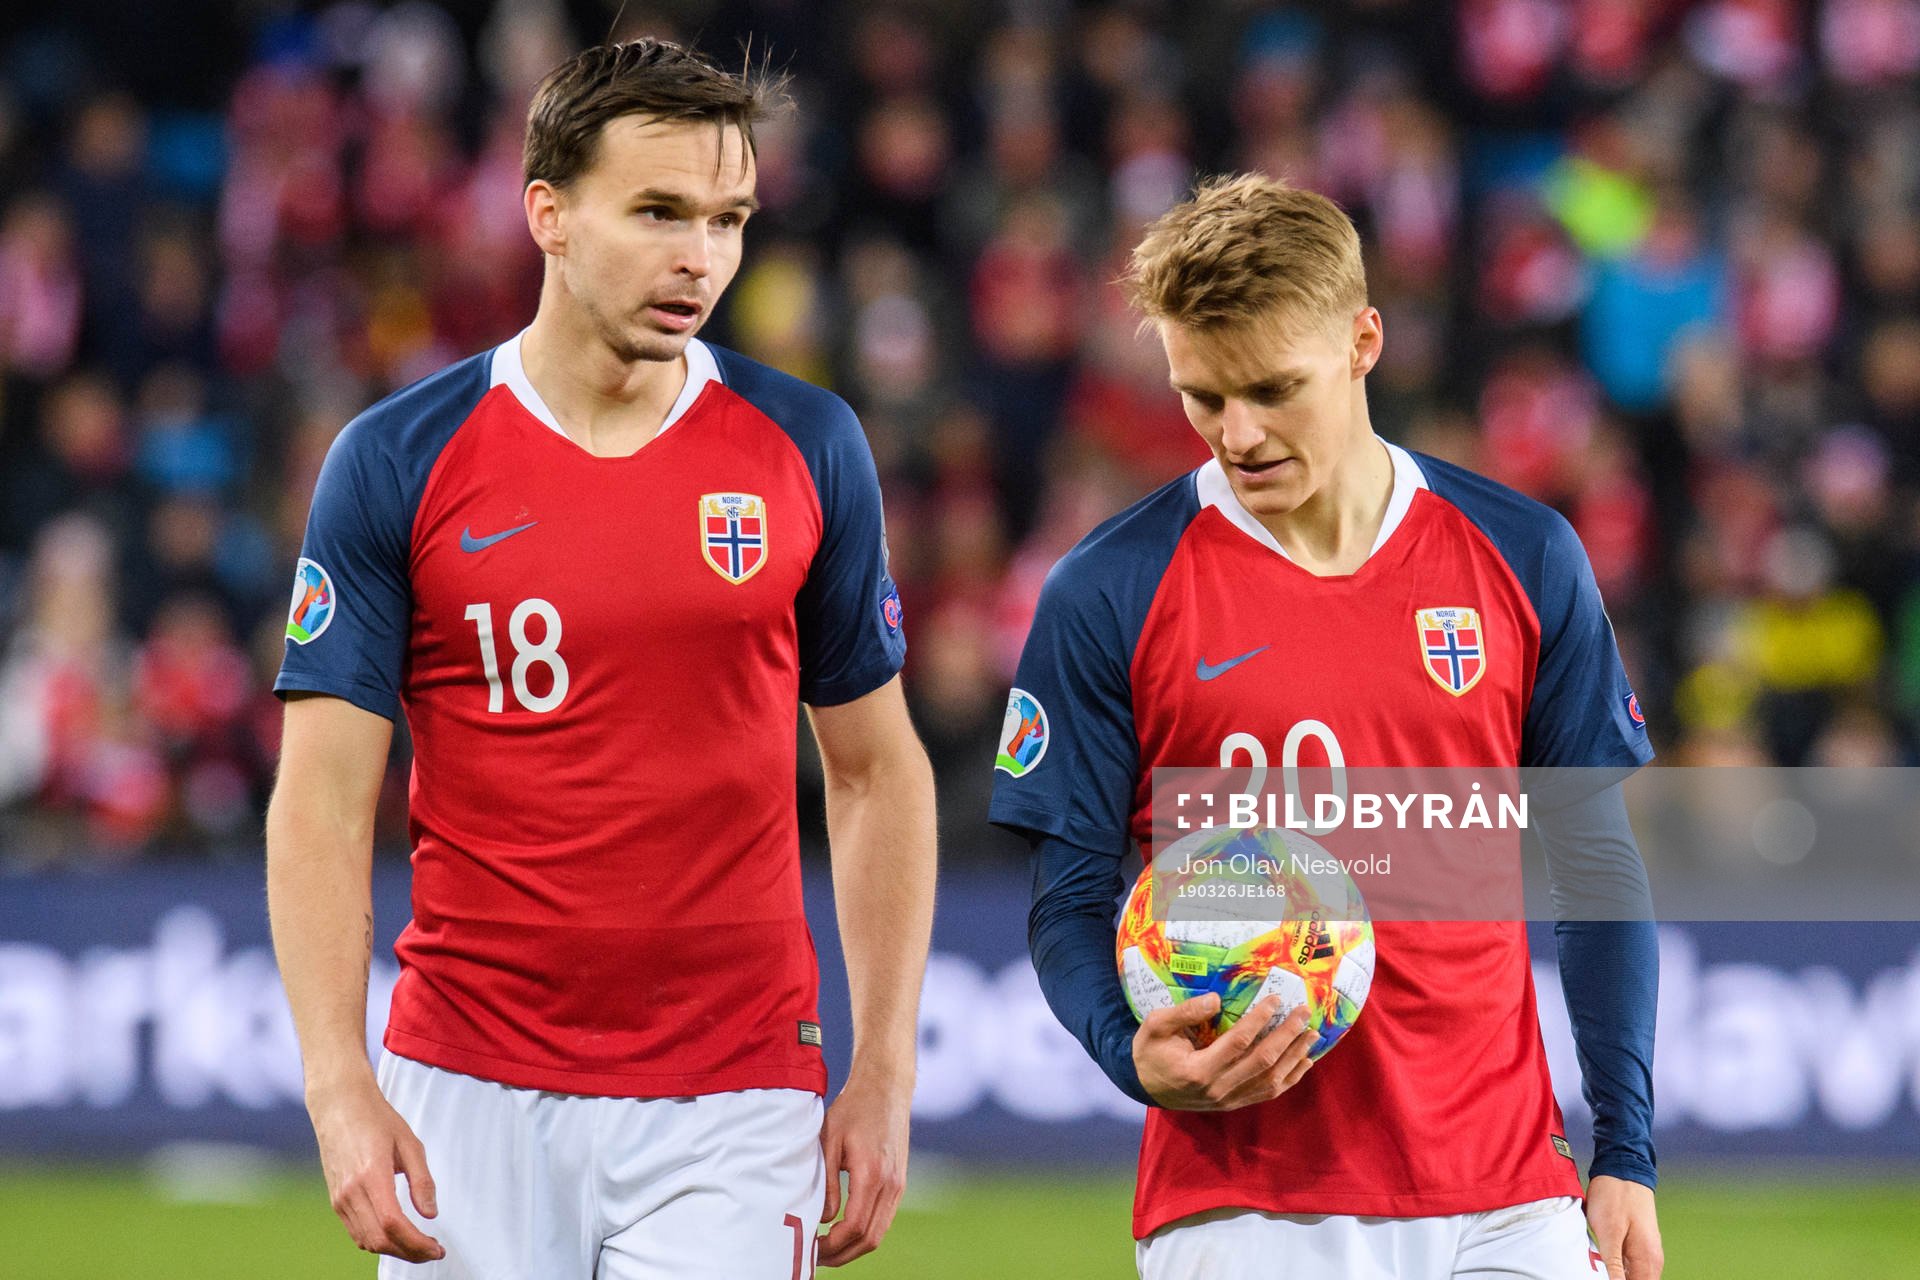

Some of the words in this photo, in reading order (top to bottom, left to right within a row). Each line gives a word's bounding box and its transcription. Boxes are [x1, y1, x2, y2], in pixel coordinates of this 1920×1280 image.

[721, 496, 743, 504] NORGE
[464, 598, 569, 713] 18
[1220, 719, 1348, 836] 20
[1297, 911, 1320, 965] adidas
[783, 1213, 815, 1280] 1
